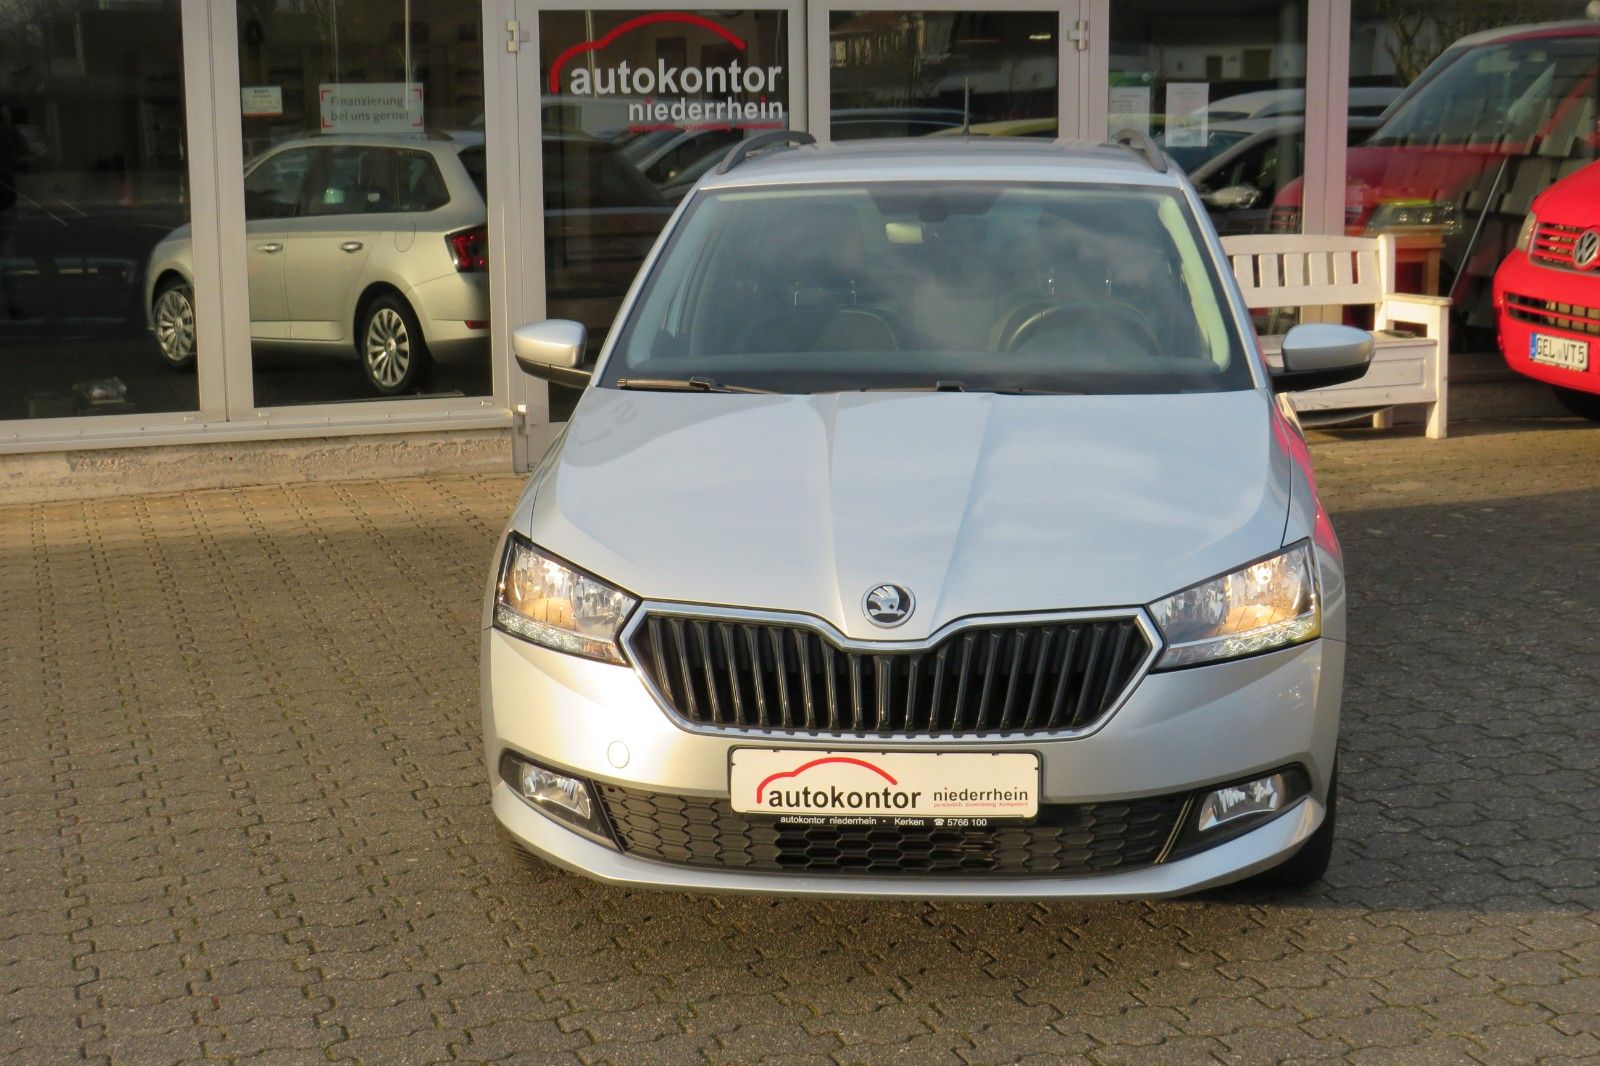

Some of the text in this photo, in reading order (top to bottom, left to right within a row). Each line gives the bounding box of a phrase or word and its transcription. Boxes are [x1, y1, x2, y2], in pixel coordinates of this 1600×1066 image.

[570, 58, 782, 95] autokontor
[330, 96, 403, 109] Fnanzierung
[629, 96, 783, 121] niederrhein
[351, 112, 370, 121] uns
[1537, 337, 1555, 358] GEL
[768, 786, 1028, 809] autokontor niederrhein
[780, 815, 987, 827] autokontor niederrhein Kerken 5766 100
